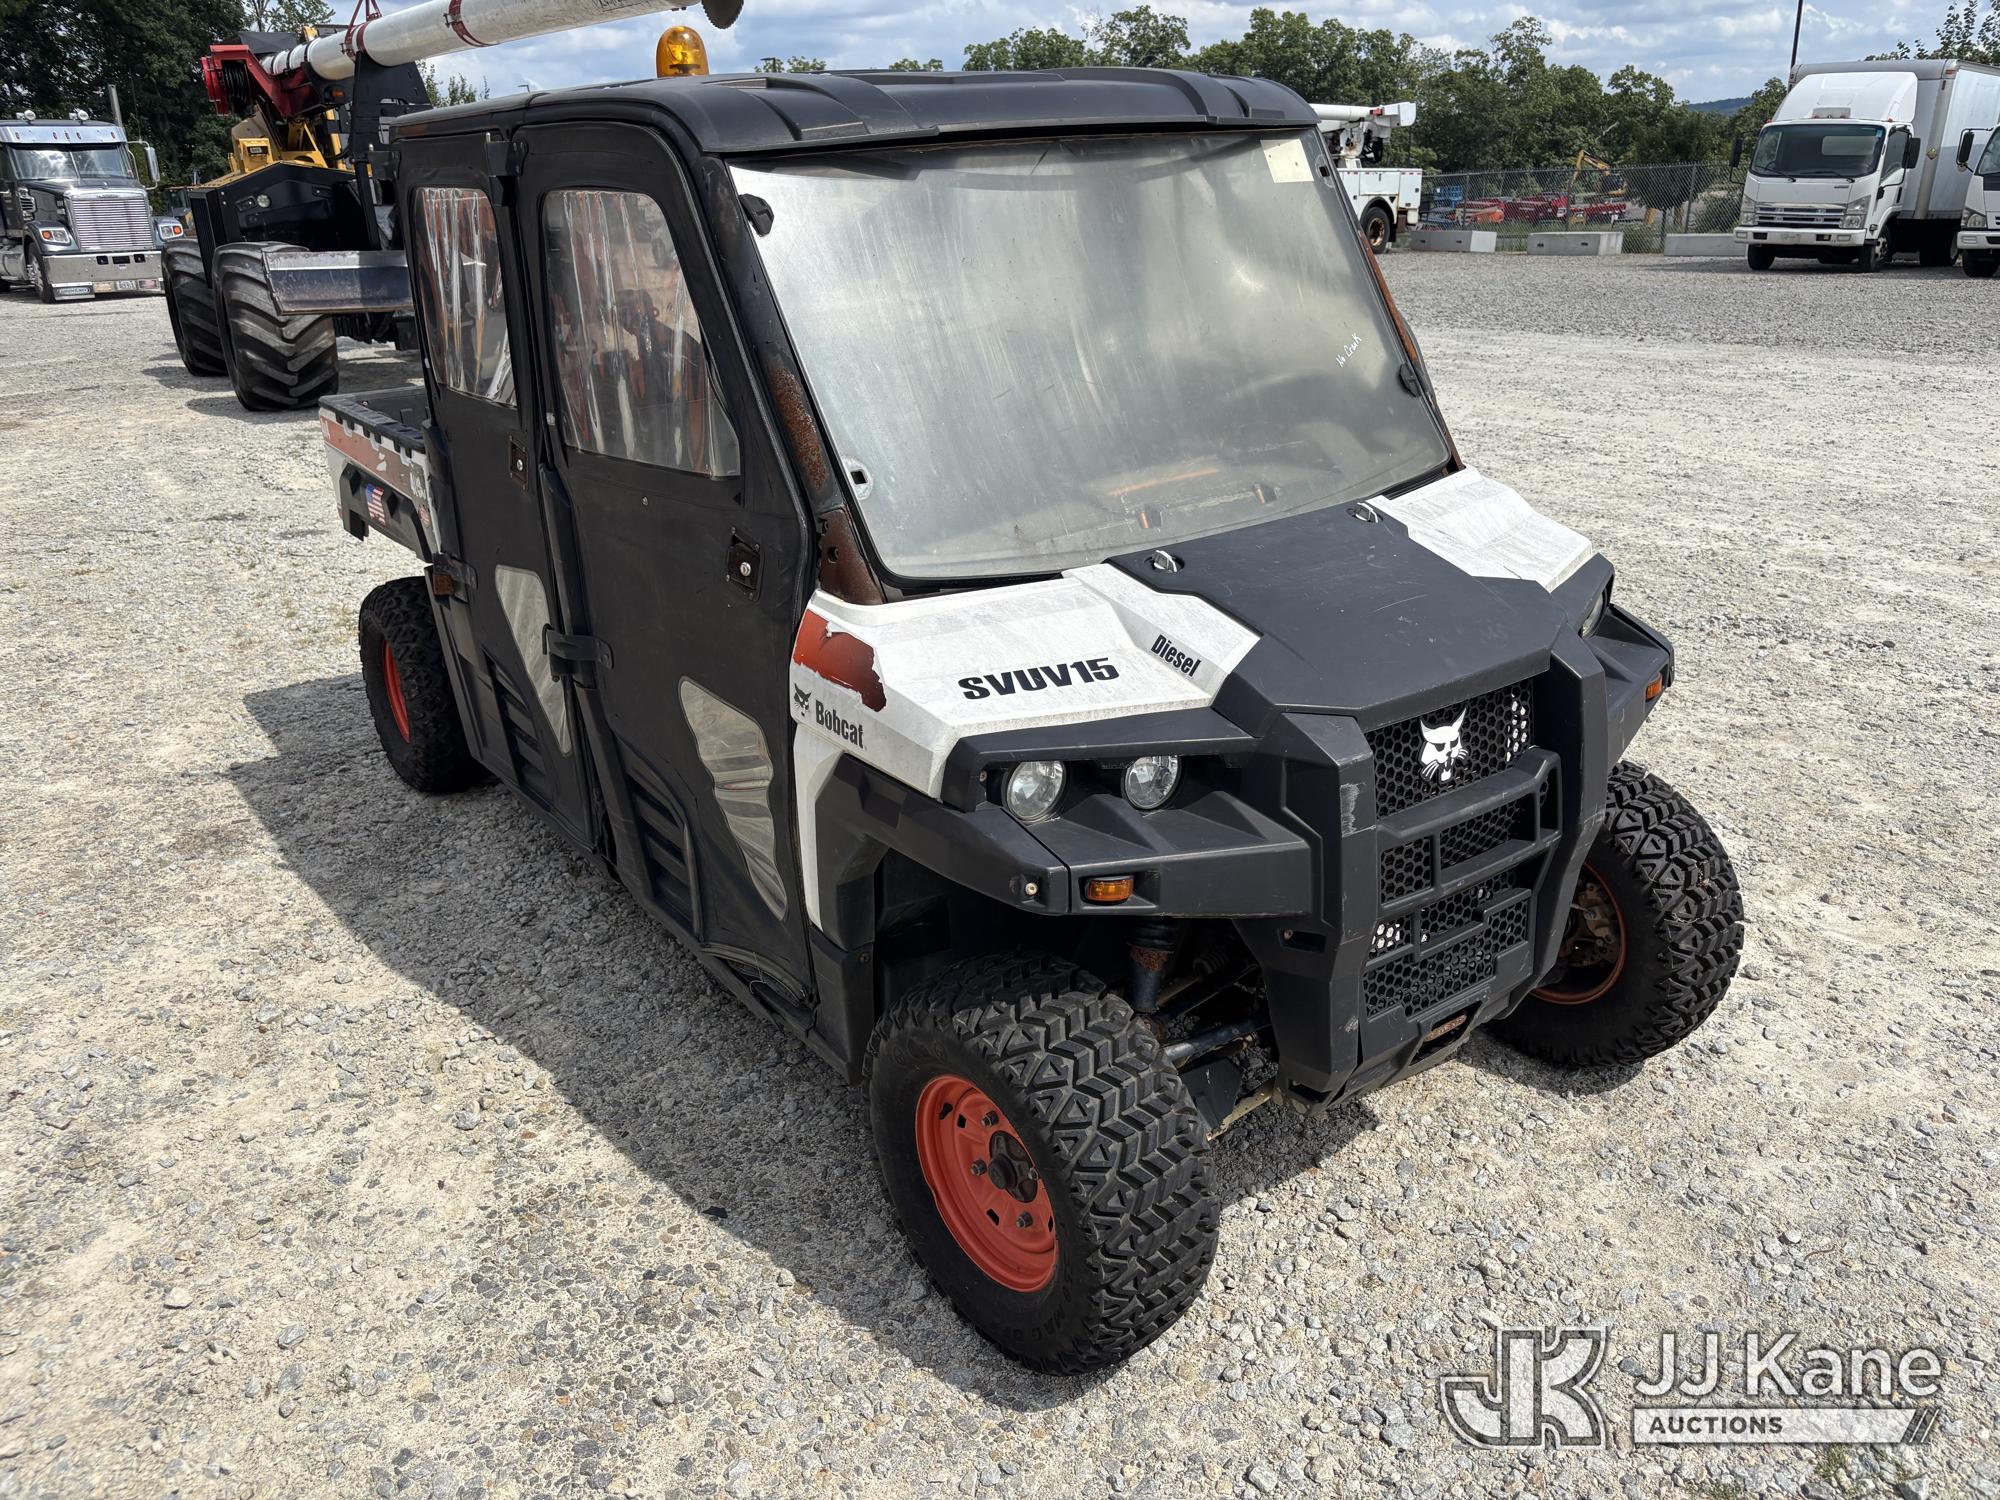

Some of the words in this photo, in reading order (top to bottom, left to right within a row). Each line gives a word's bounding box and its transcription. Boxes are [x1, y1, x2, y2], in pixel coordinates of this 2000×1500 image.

[957, 656, 1120, 700] SVUV15
[1150, 633, 1202, 679] Diesel
[815, 699, 865, 749] Bobcat
